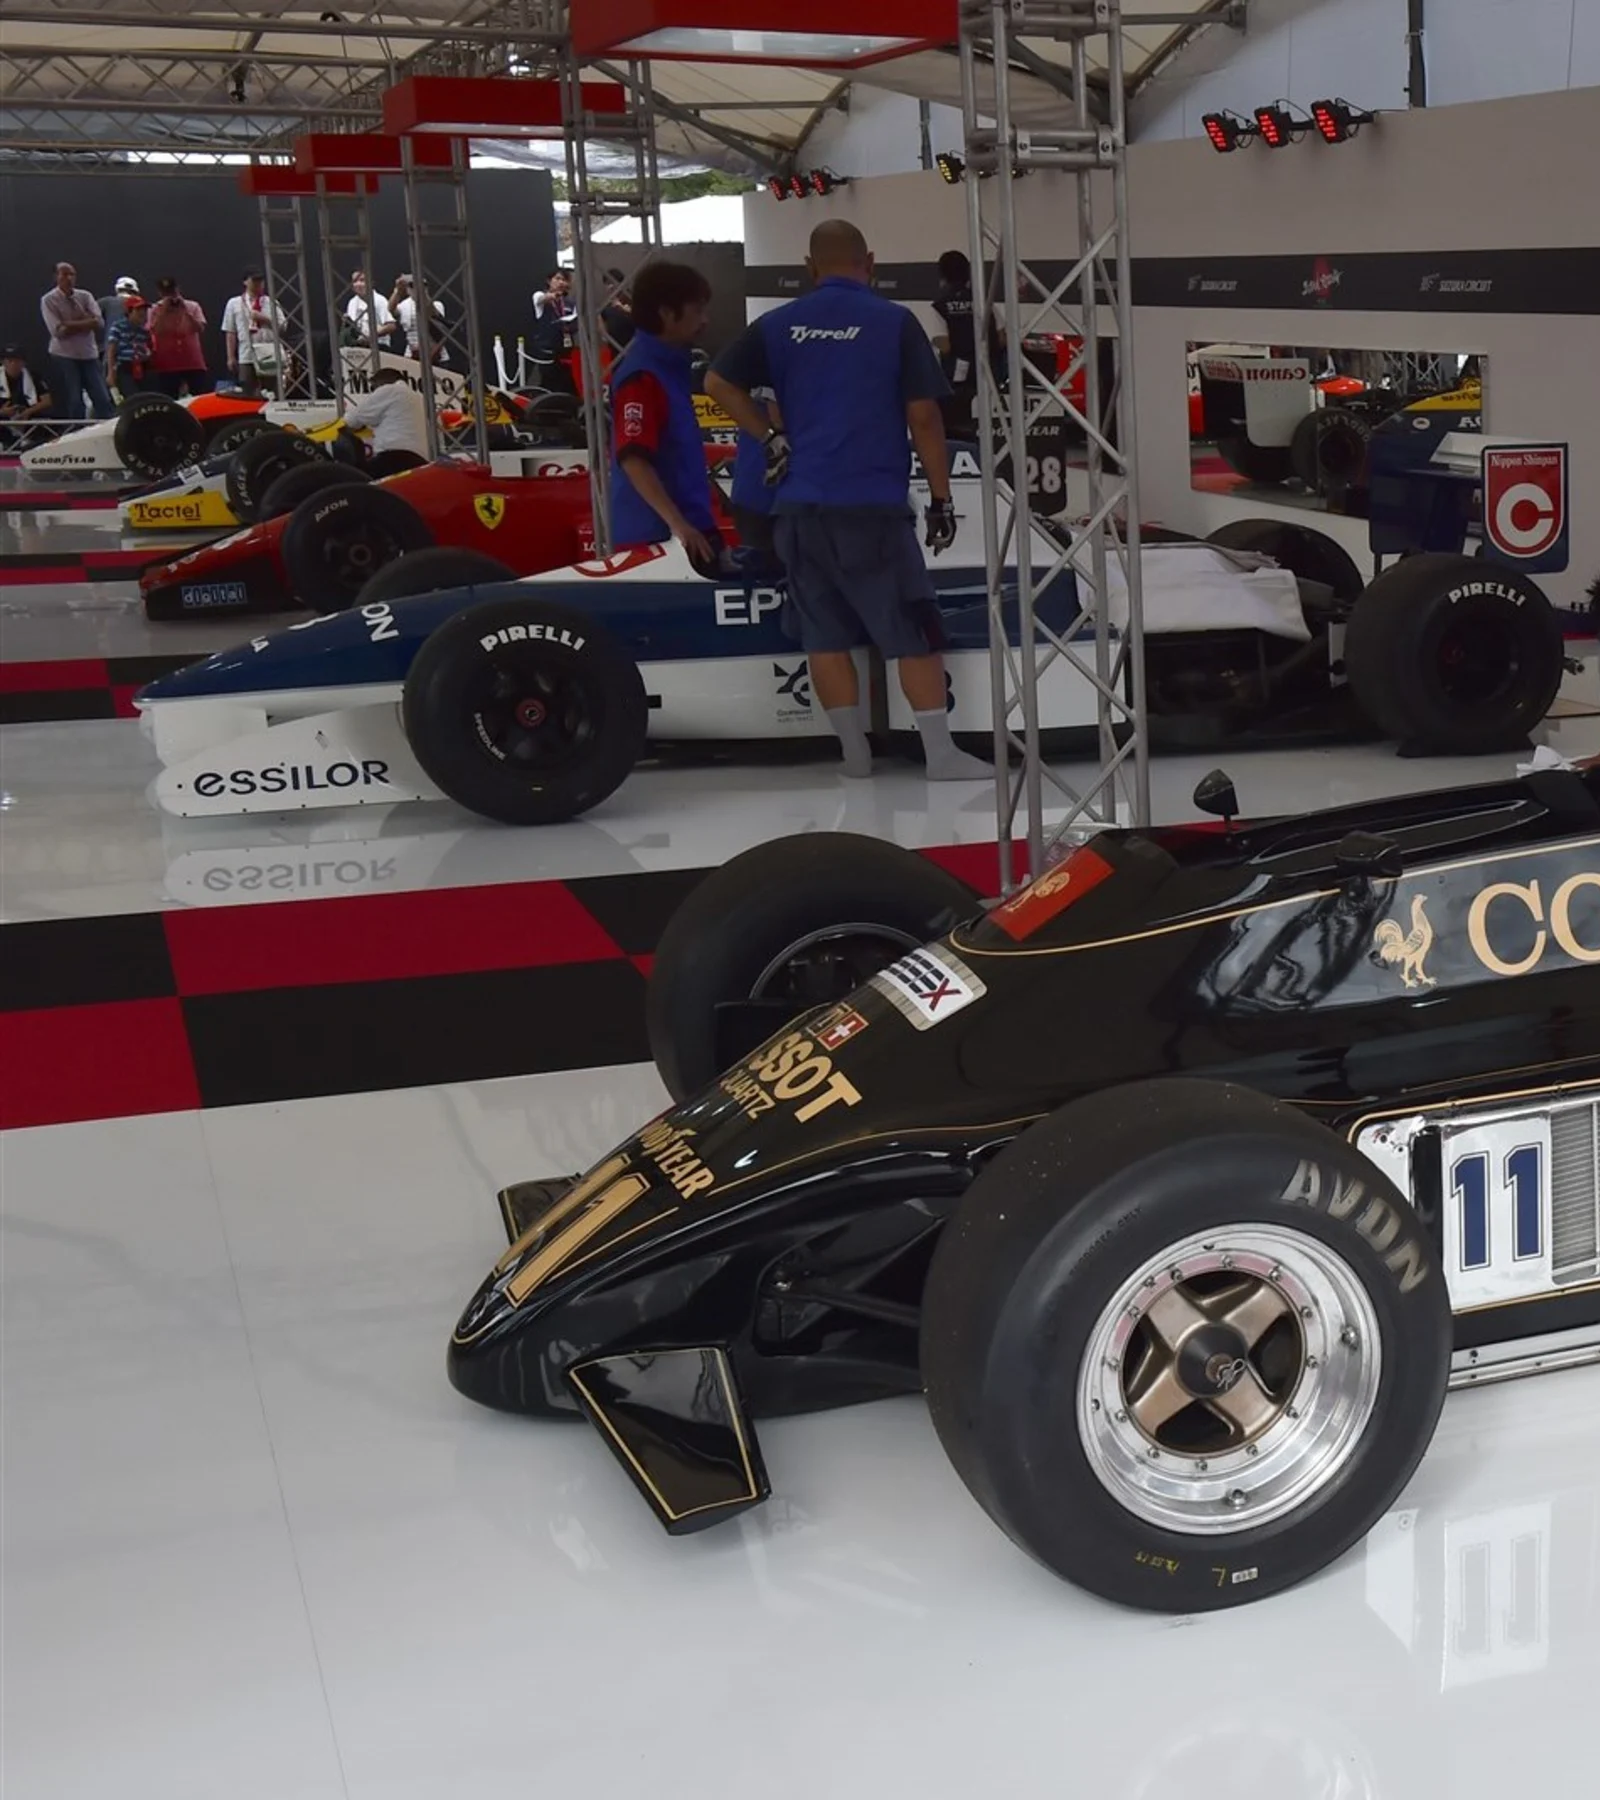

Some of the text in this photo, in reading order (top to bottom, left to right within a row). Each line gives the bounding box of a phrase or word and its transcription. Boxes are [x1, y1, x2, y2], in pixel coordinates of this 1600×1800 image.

[789, 325, 862, 344] Tyrrell
[1491, 454, 1558, 468] Nippon Shinpan
[134, 503, 200, 519] Tactel
[1448, 581, 1526, 608] PIRELLI
[480, 624, 585, 652] PIRELLI
[1449, 1141, 1546, 1272] 11
[1280, 1158, 1430, 1294] AVON
